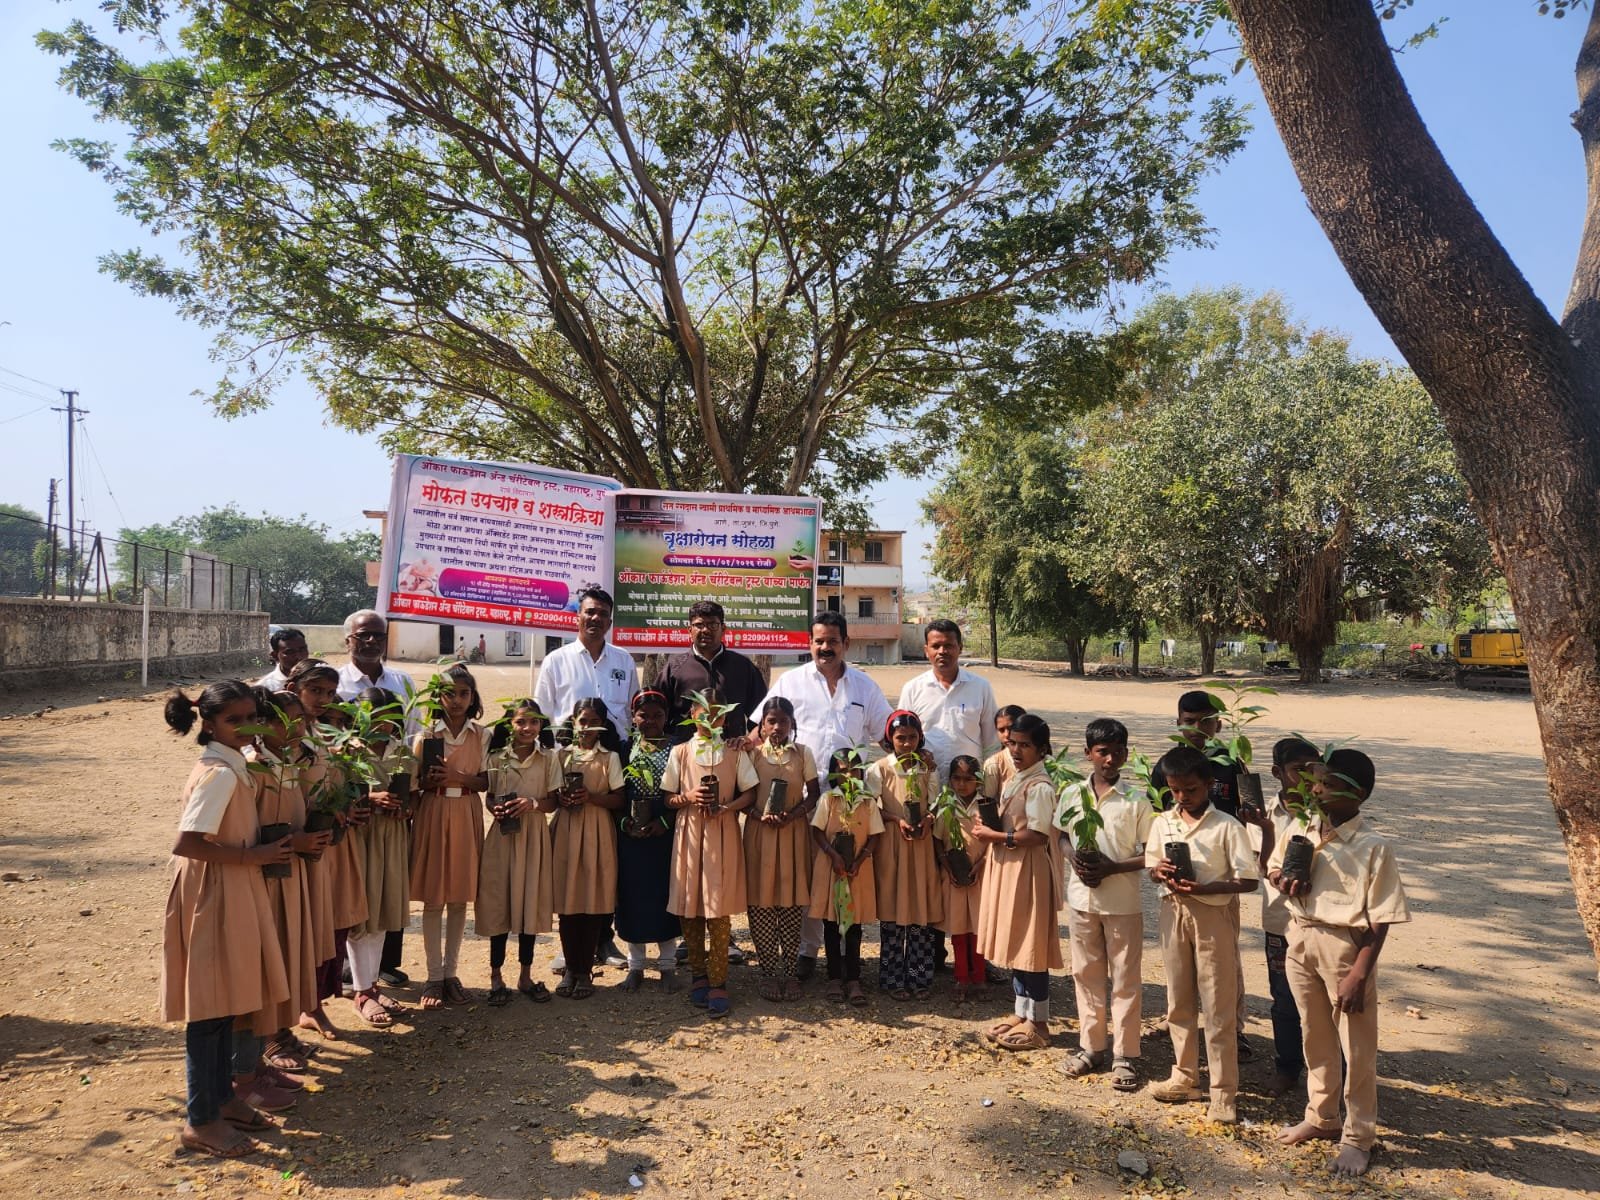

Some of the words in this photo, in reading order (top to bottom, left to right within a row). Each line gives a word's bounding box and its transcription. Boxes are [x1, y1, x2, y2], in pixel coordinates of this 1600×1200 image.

[422, 479, 467, 505] मोफत
[471, 492, 519, 514] उपचार
[523, 499, 535, 516] व
[539, 502, 605, 526] शस्त्रक्रिया
[460, 514, 478, 523] समाज
[443, 523, 462, 532] आजार
[464, 526, 483, 535] अथवा
[512, 533, 528, 541] झाला
[474, 549, 490, 558] मोफत
[742, 633, 789, 642] 9209041154
